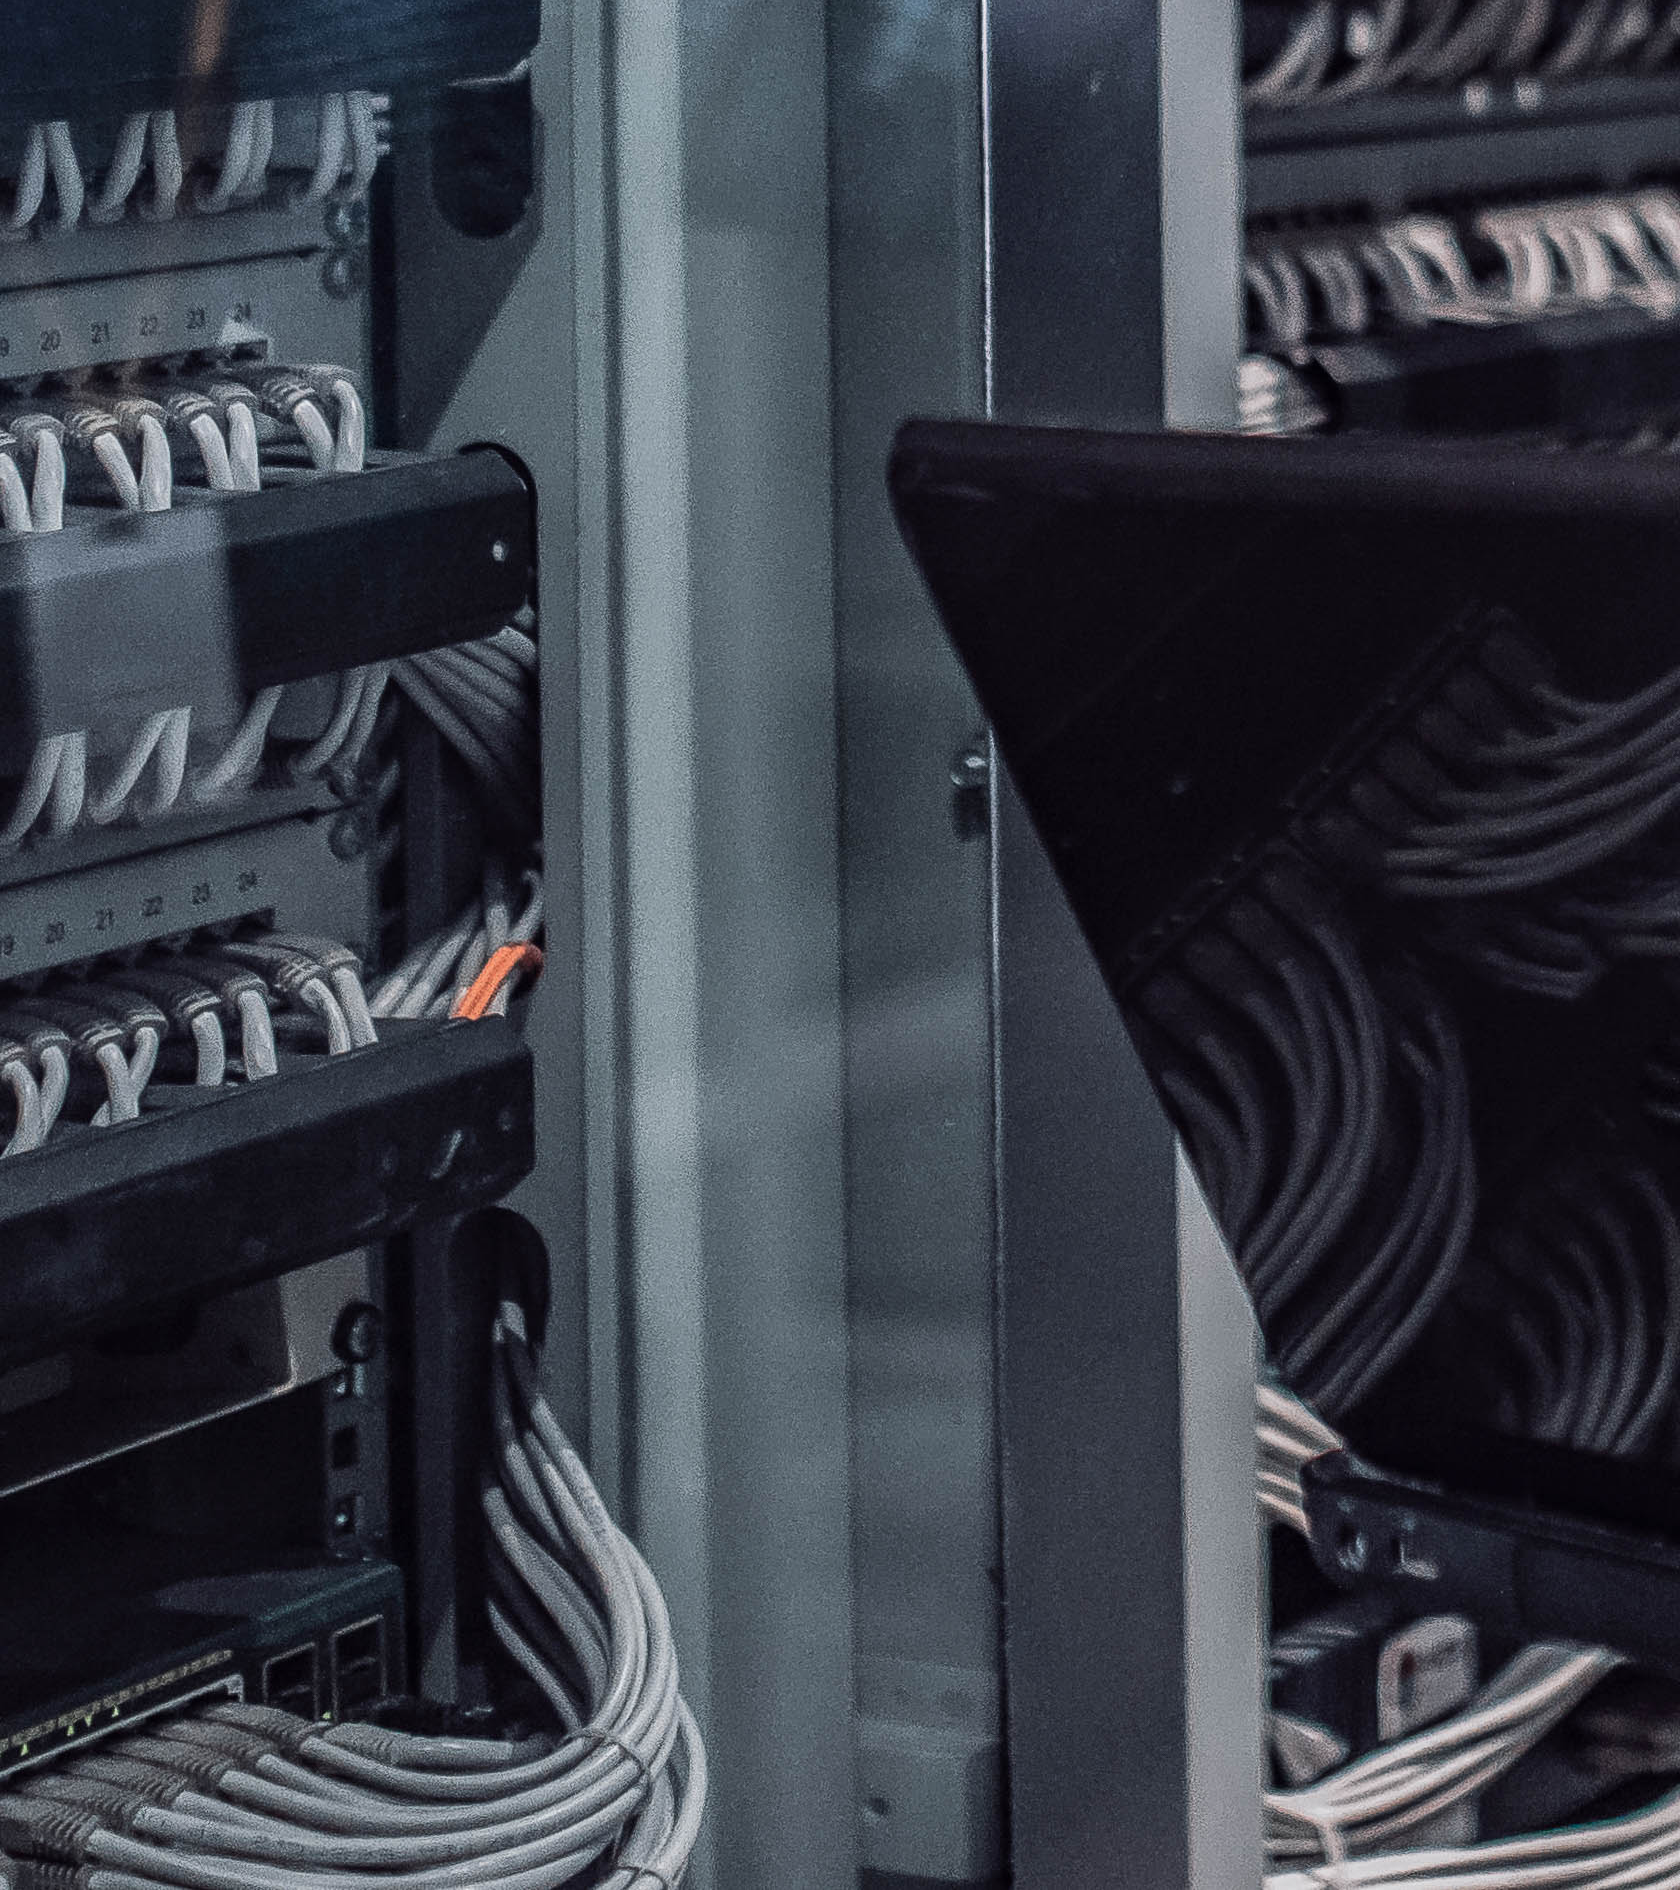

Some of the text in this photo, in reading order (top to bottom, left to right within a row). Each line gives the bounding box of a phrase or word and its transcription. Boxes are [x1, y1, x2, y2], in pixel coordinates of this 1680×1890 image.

[41, 330, 60, 352] 20
[91, 322, 110, 345] 21
[140, 315, 158, 336] 22
